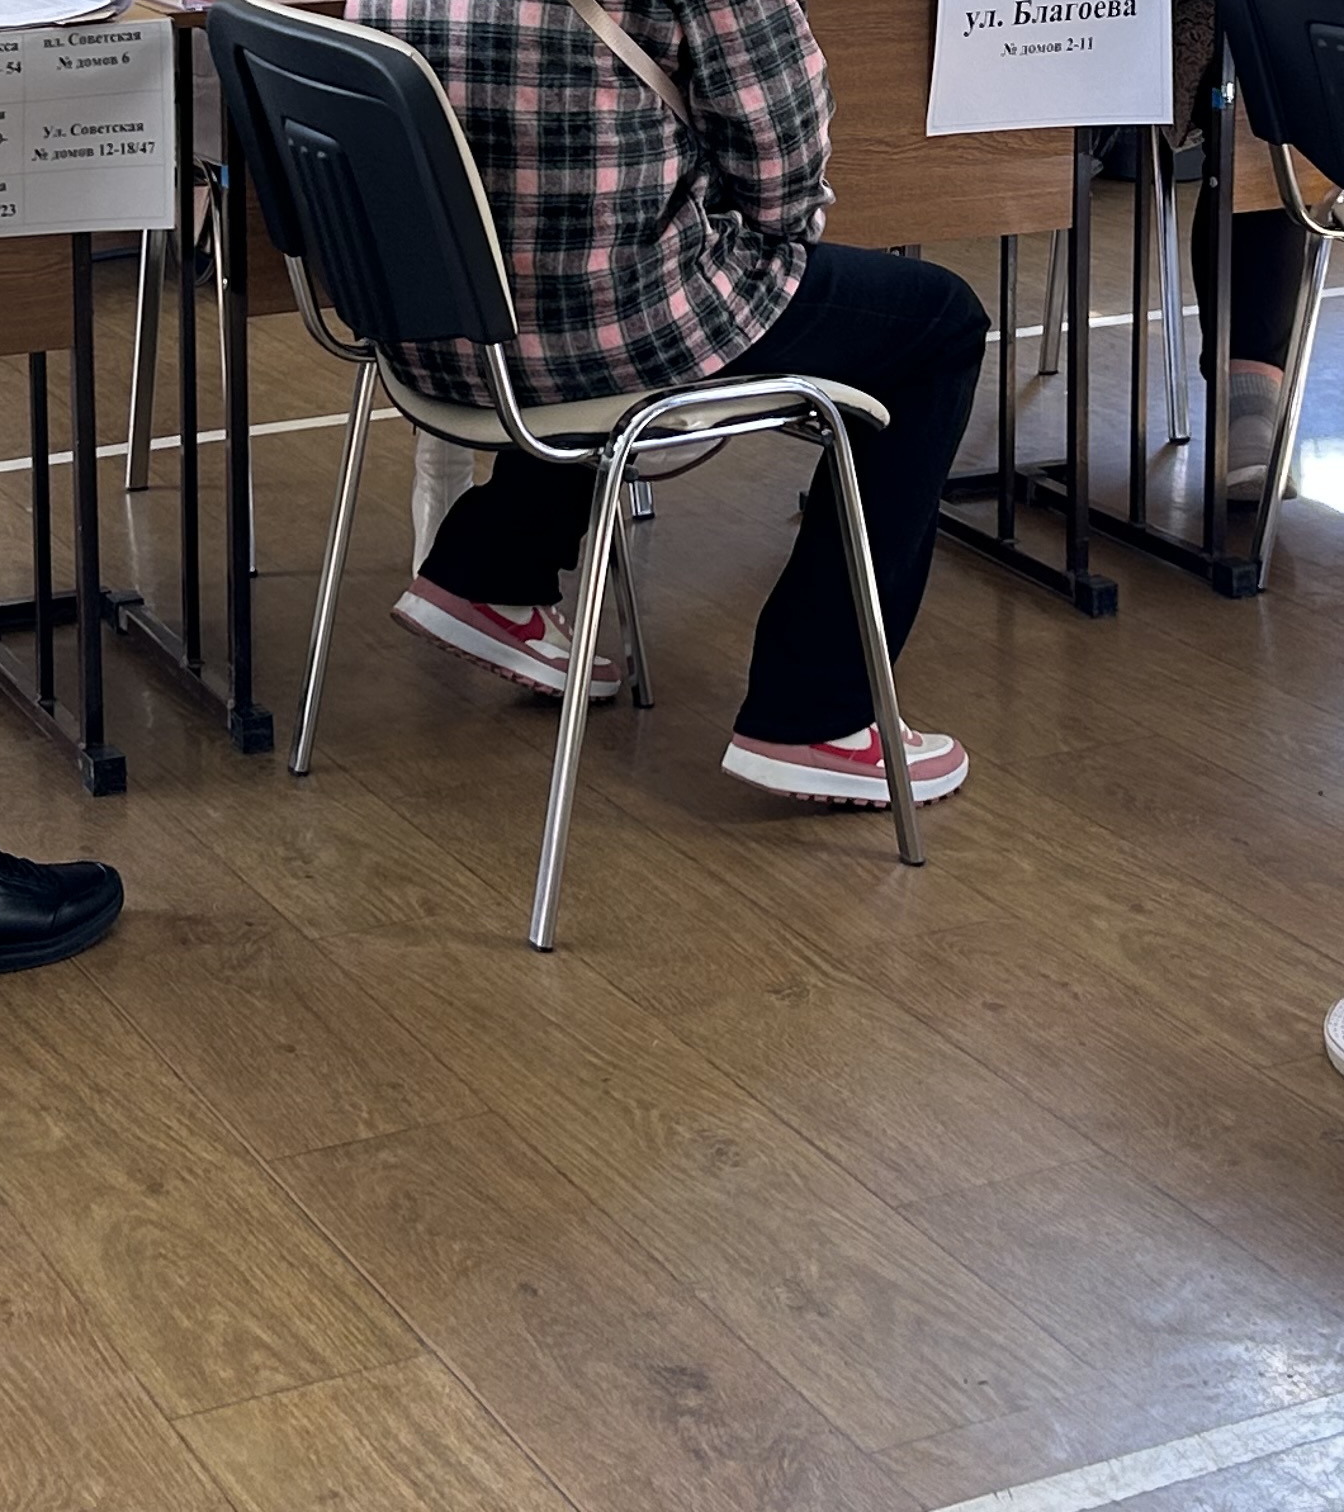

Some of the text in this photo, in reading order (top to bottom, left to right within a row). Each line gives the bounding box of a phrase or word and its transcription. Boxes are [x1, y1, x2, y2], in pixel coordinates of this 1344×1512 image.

[963, 9, 1003, 37] ул.
[68, 31, 142, 47] Советская
[1000, 36, 1094, 57] № домов 2-11
[5, 61, 22, 75] 54
[57, 51, 131, 70] № домов 6
[70, 123, 144, 136] Советская
[31, 141, 155, 162] № домов 12-18/47
